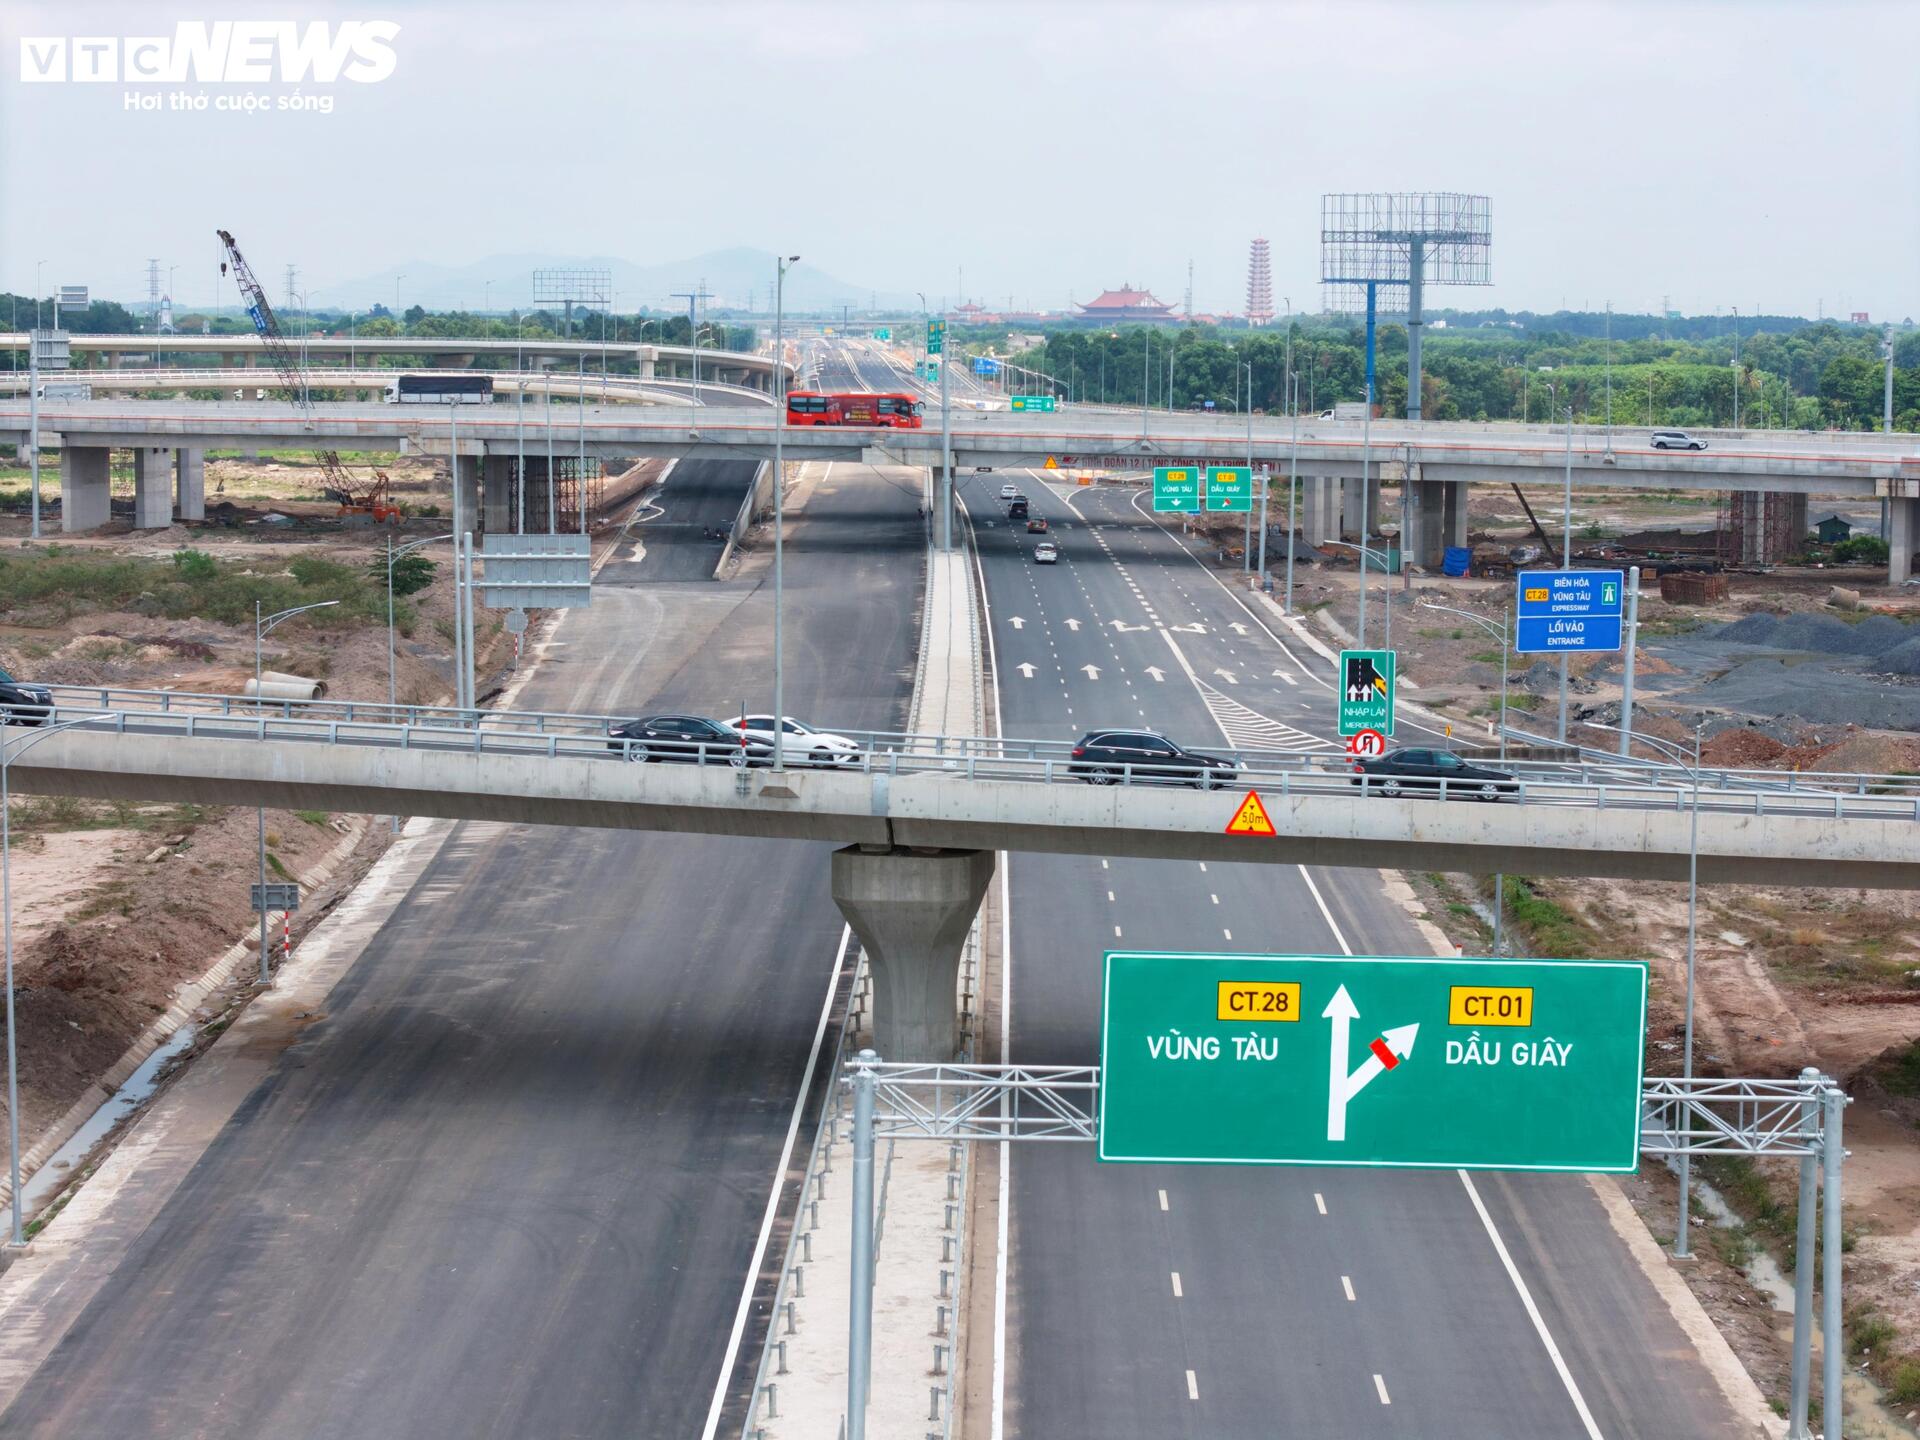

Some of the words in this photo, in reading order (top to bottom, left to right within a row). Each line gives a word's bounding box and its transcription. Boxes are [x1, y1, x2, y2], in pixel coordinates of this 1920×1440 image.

[1554, 576, 1572, 588] BIÊN
[1573, 576, 1590, 588] HÒA
[1526, 590, 1548, 600] CT.28
[1553, 591, 1574, 601] VŨNG
[1576, 591, 1591, 601] TÀU
[1552, 604, 1590, 612] EXPRESSWAY
[1549, 619, 1564, 633] LỐI
[1565, 620, 1584, 633] VÀO
[1547, 637, 1585, 646] ENTRANCE
[1229, 991, 1289, 1013] CT.28
[1463, 995, 1524, 1018] CT.01
[1147, 1029, 1220, 1061] VŨNG
[1232, 1031, 1279, 1061] TÀU
[1445, 1031, 1501, 1065] DẦU
[1510, 1038, 1573, 1067] GIÂY
